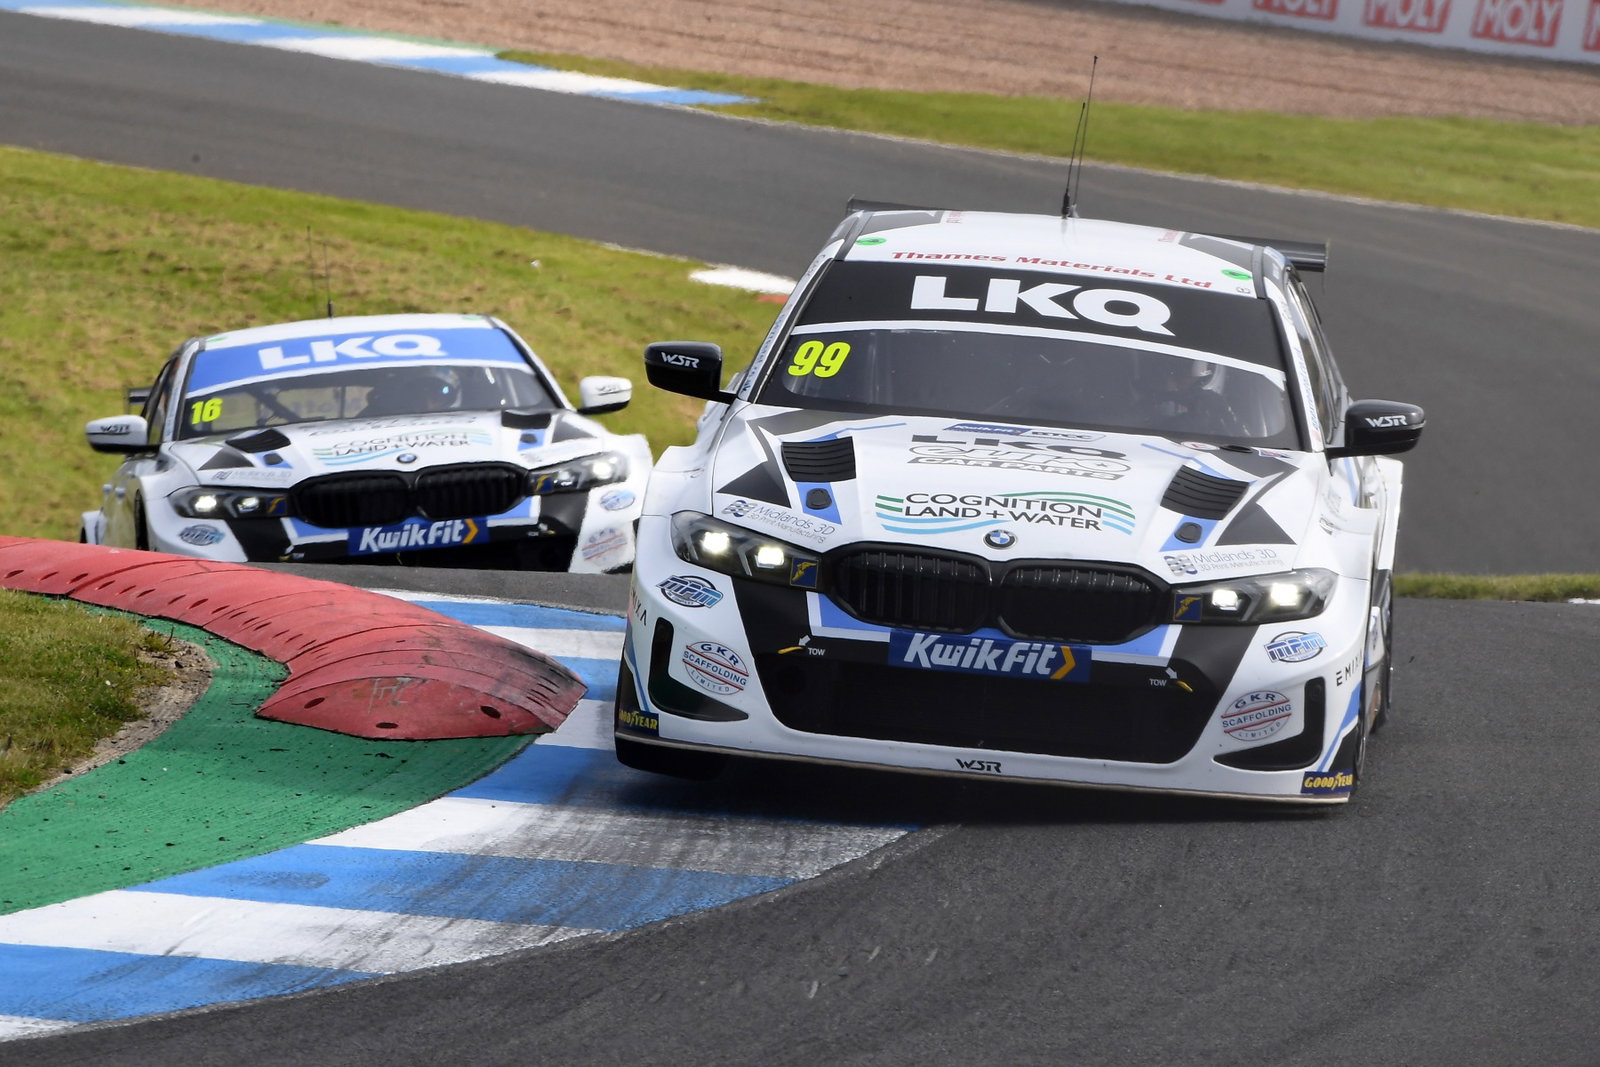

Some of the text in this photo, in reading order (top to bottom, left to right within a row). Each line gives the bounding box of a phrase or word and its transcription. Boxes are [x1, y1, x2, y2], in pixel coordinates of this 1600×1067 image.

[1475, 0, 1562, 42] MOLY
[892, 252, 1212, 289] Thames Materials Ltd
[911, 275, 1176, 337] LKQ
[258, 334, 449, 370] LKQ
[661, 352, 700, 369] WSR
[788, 340, 851, 378] 99
[191, 398, 223, 424] 16
[1365, 415, 1408, 428] WSR
[333, 433, 468, 448] COGNITION
[911, 434, 1129, 461] LKQ
[917, 456, 1117, 481] CAR PARTS
[905, 493, 1102, 519] COGNITION
[755, 507, 836, 536] Midlands 3D
[1192, 548, 1277, 564] Midlands 3D
[701, 643, 739, 666] GKR
[808, 648, 825, 656] TOW
[683, 650, 747, 686] SCAFFOLDING
[691, 669, 730, 692] LIMITED
[1149, 679, 1167, 687] TOW
[1235, 693, 1276, 709] GKR
[1222, 704, 1292, 728] SCAFFOLDING
[955, 758, 1001, 773] WSR
